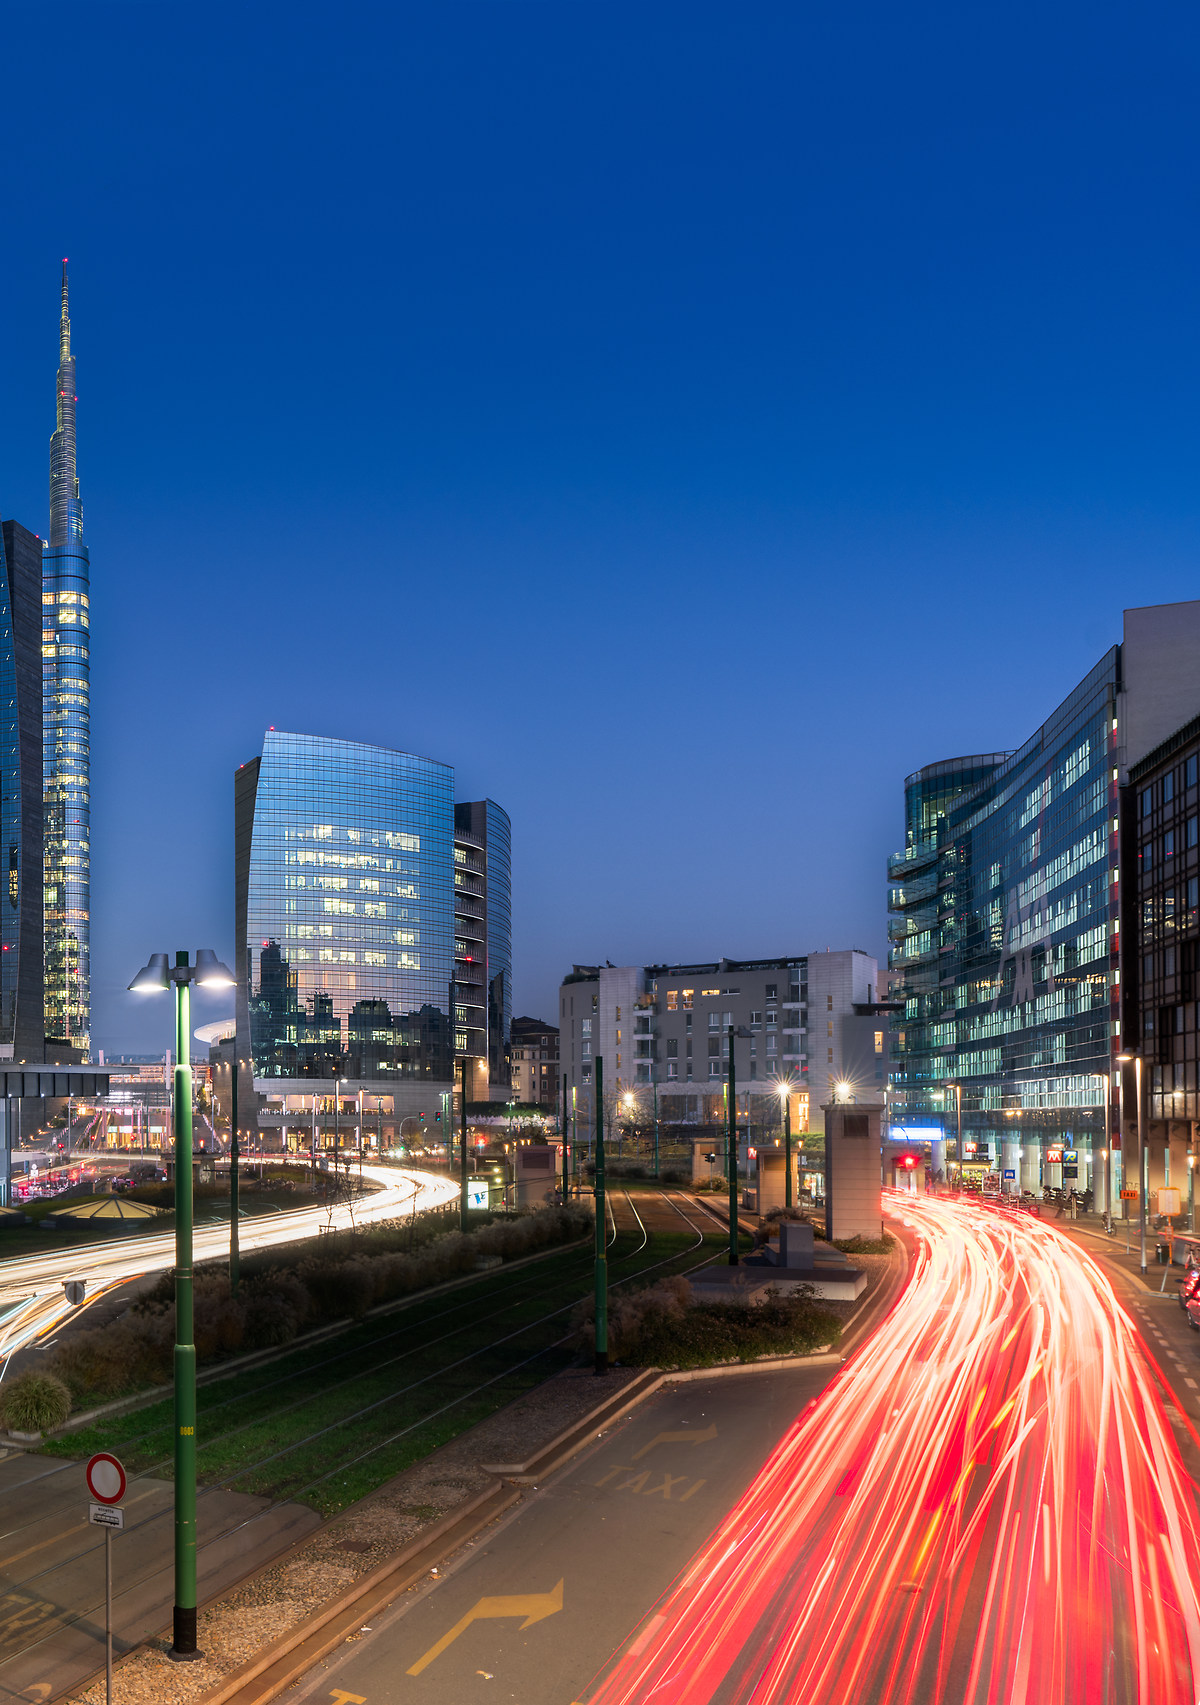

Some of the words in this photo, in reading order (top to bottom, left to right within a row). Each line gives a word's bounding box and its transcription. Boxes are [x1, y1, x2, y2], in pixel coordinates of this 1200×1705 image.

[1048, 1150, 1061, 1161] M
[1065, 1153, 1077, 1162] R
[595, 1464, 707, 1502] TAXI
